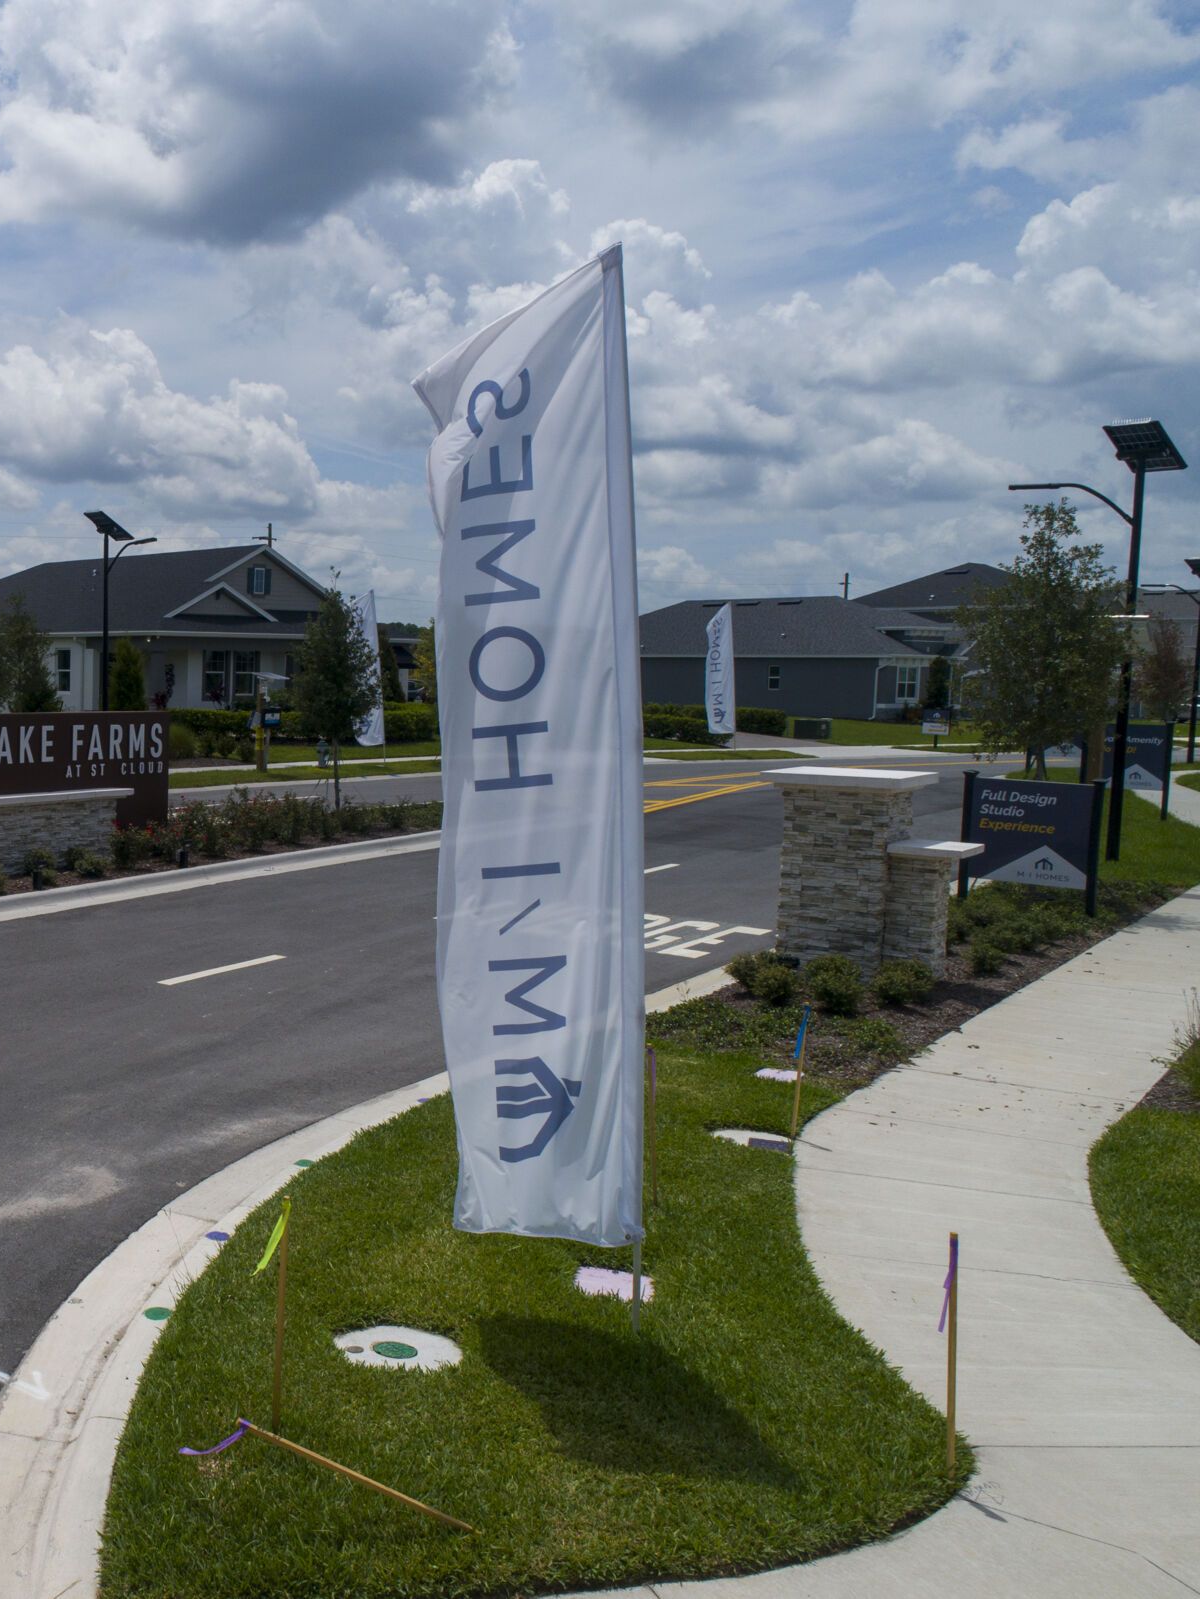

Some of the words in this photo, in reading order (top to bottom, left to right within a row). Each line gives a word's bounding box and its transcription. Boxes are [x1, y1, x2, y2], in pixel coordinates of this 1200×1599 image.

[71, 723, 164, 761] FARMS
[65, 764, 81, 778] AT
[91, 763, 105, 777] ST
[121, 761, 163, 775] CLOUD
[981, 789, 1006, 801] Full
[1009, 791, 1057, 807] Design
[979, 803, 1025, 817] Studio
[979, 818, 1056, 834] Experience
[1035, 872, 1070, 882] HOMES
